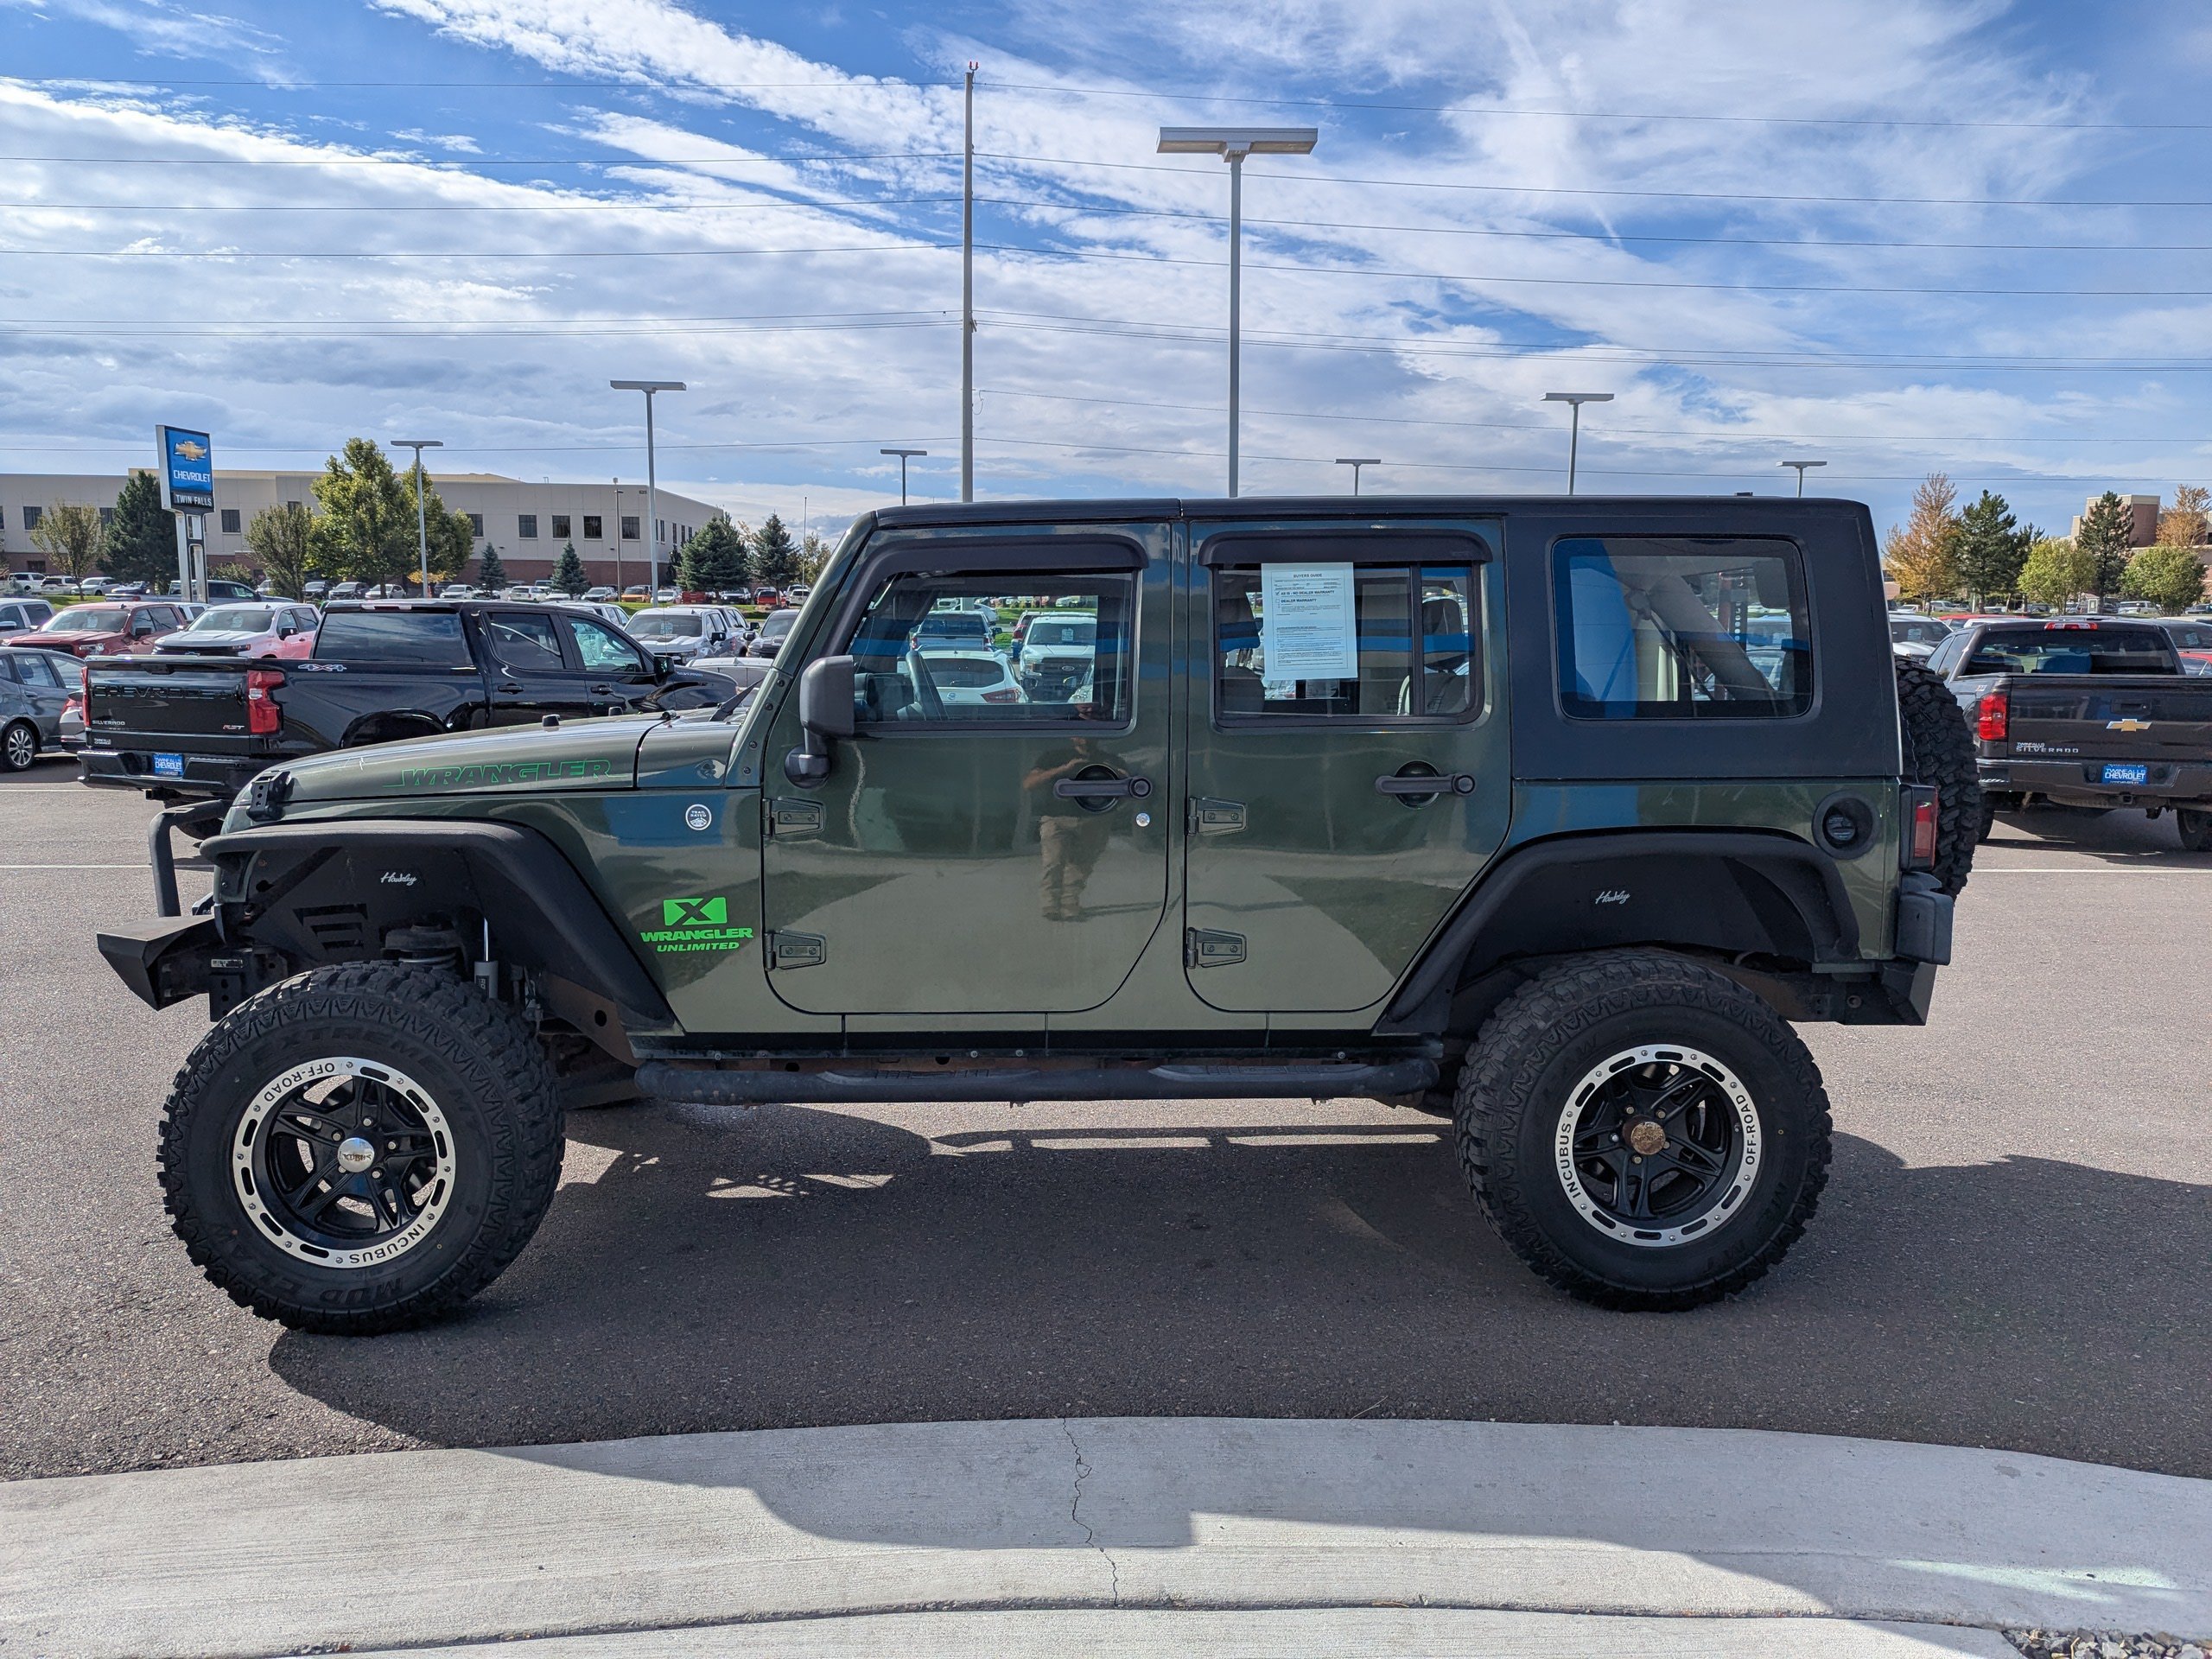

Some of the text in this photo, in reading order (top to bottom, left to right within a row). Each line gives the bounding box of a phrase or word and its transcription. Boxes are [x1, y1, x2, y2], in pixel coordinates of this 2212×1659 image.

[173, 469, 211, 482] CHEVROLET
[175, 494, 213, 506] TWIN FALLS
[155, 761, 182, 770] CHEVROLET
[401, 760, 612, 788] WRANGLER
[2104, 772, 2145, 780] CHEVROLET
[640, 927, 754, 943] WRANGLER
[656, 941, 740, 953] UNLIMITED
[264, 1062, 335, 1102] OFF-ROAD
[1735, 1094, 1757, 1166] OFF-ROAD
[1559, 1122, 1582, 1199] INCUBUS
[349, 1223, 426, 1264] INCUBUS
